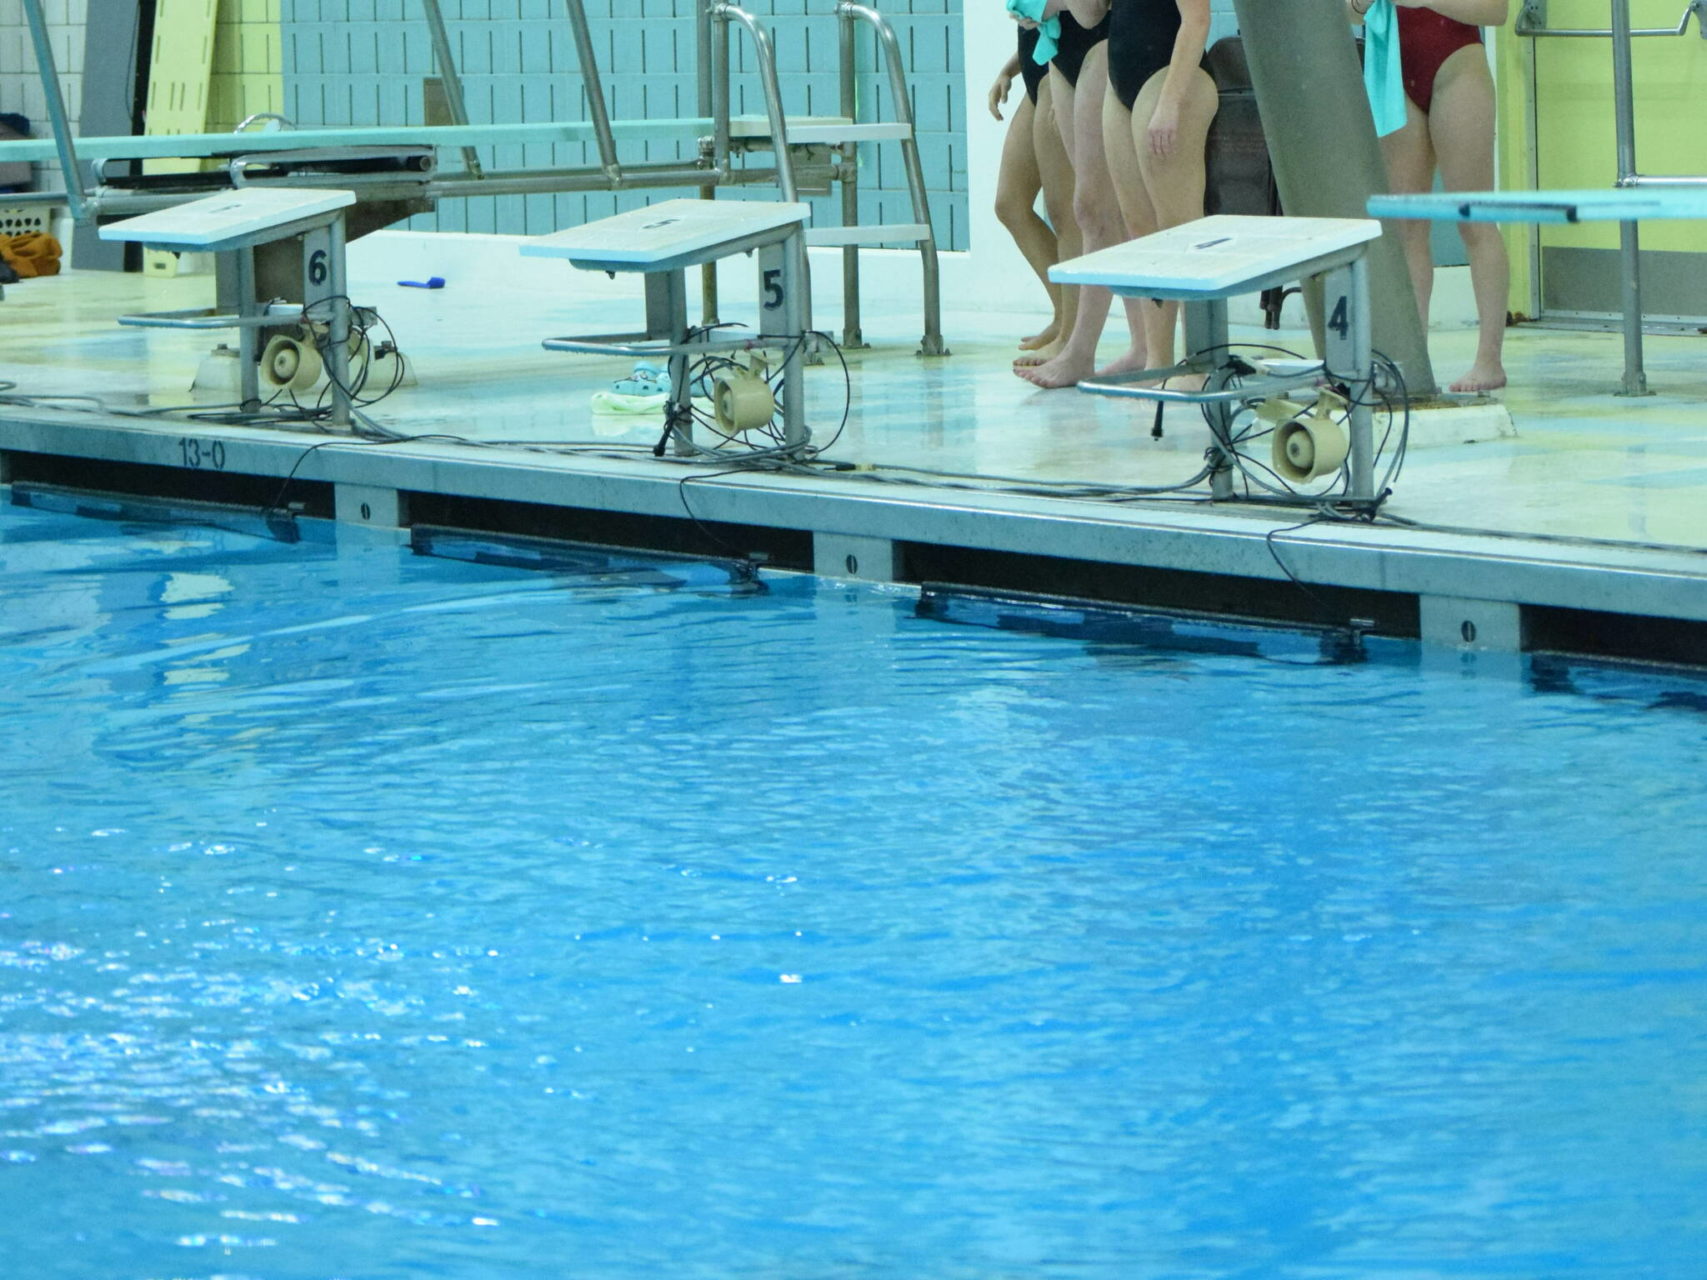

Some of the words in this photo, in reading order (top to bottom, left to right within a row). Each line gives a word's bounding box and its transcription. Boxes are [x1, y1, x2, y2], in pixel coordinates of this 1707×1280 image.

[308, 249, 328, 287] 6
[763, 269, 784, 311] 5
[1327, 295, 1349, 341] 4
[178, 437, 226, 470] 13-0
